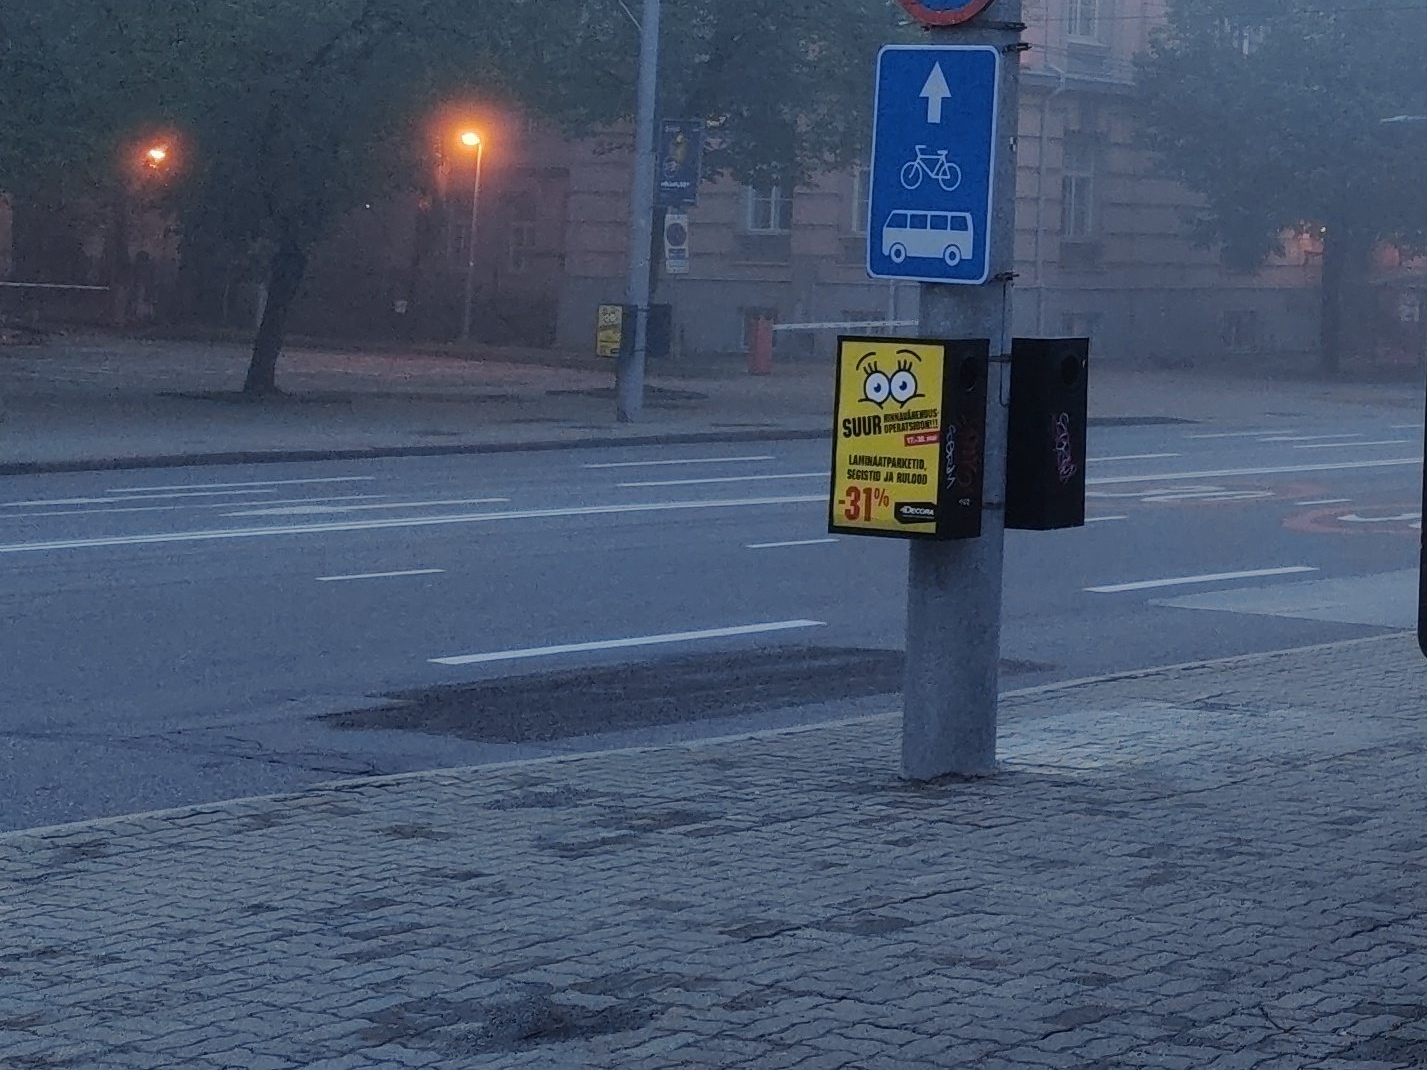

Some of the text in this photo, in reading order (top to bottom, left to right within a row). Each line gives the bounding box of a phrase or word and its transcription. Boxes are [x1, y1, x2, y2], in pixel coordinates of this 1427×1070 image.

[842, 414, 882, 438] SUUR
[846, 468, 928, 485] SEGISTID JA RULOOD
[838, 486, 890, 522] -31%
